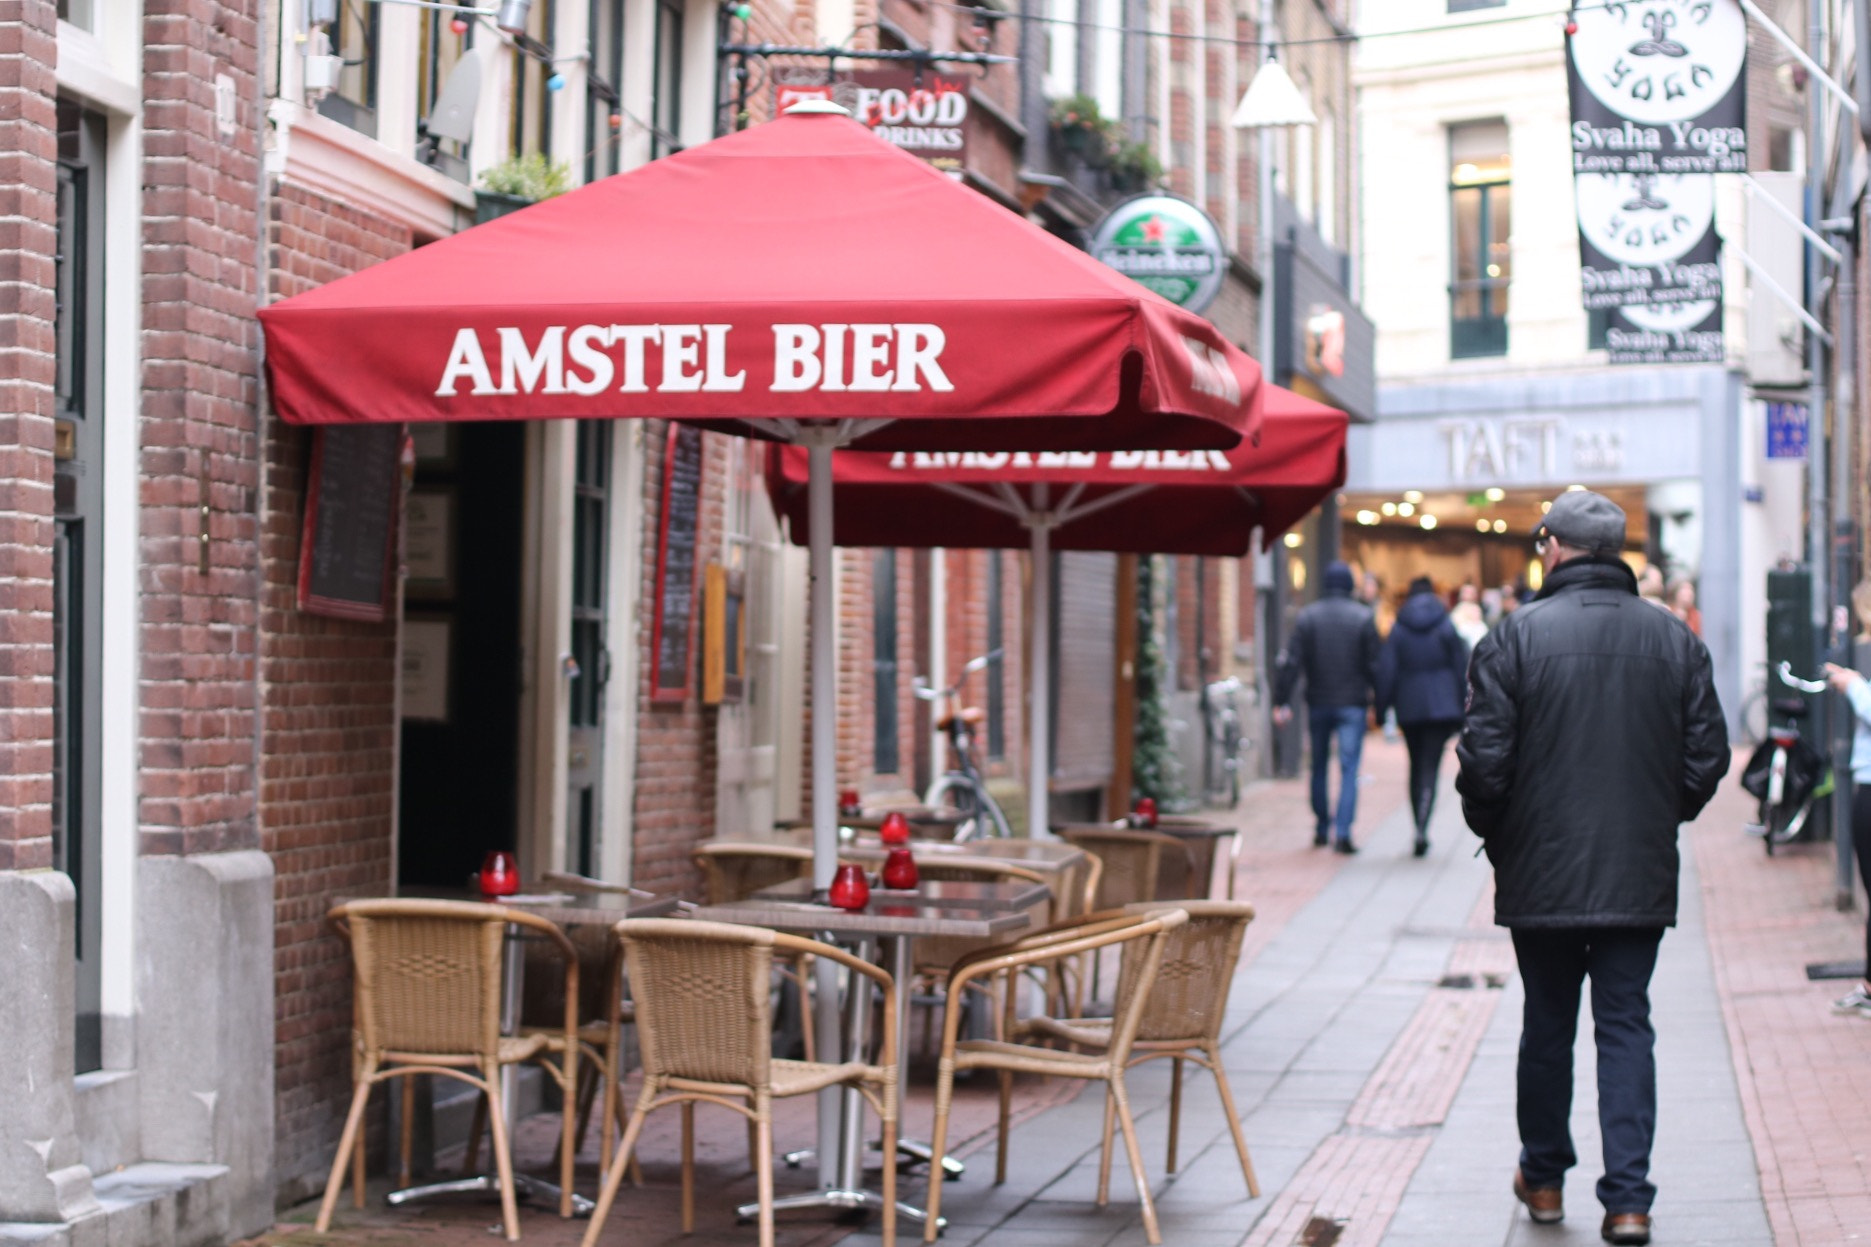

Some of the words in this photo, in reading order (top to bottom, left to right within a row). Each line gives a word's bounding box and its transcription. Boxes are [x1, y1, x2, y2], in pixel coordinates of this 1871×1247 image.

[855, 88, 968, 126] FOOD
[876, 126, 964, 150] DRINKS
[1572, 120, 1663, 150] Svaha
[1669, 120, 1746, 157] Yoga
[1573, 152, 1624, 171] Love
[1660, 155, 1717, 171] serve
[1718, 151, 1747, 171] all
[1582, 265, 1653, 290] Svaha
[1657, 260, 1720, 289] Yoga
[435, 324, 746, 397] AMSTEL
[769, 323, 955, 392] BIER
[1441, 416, 1565, 479] TAFT
